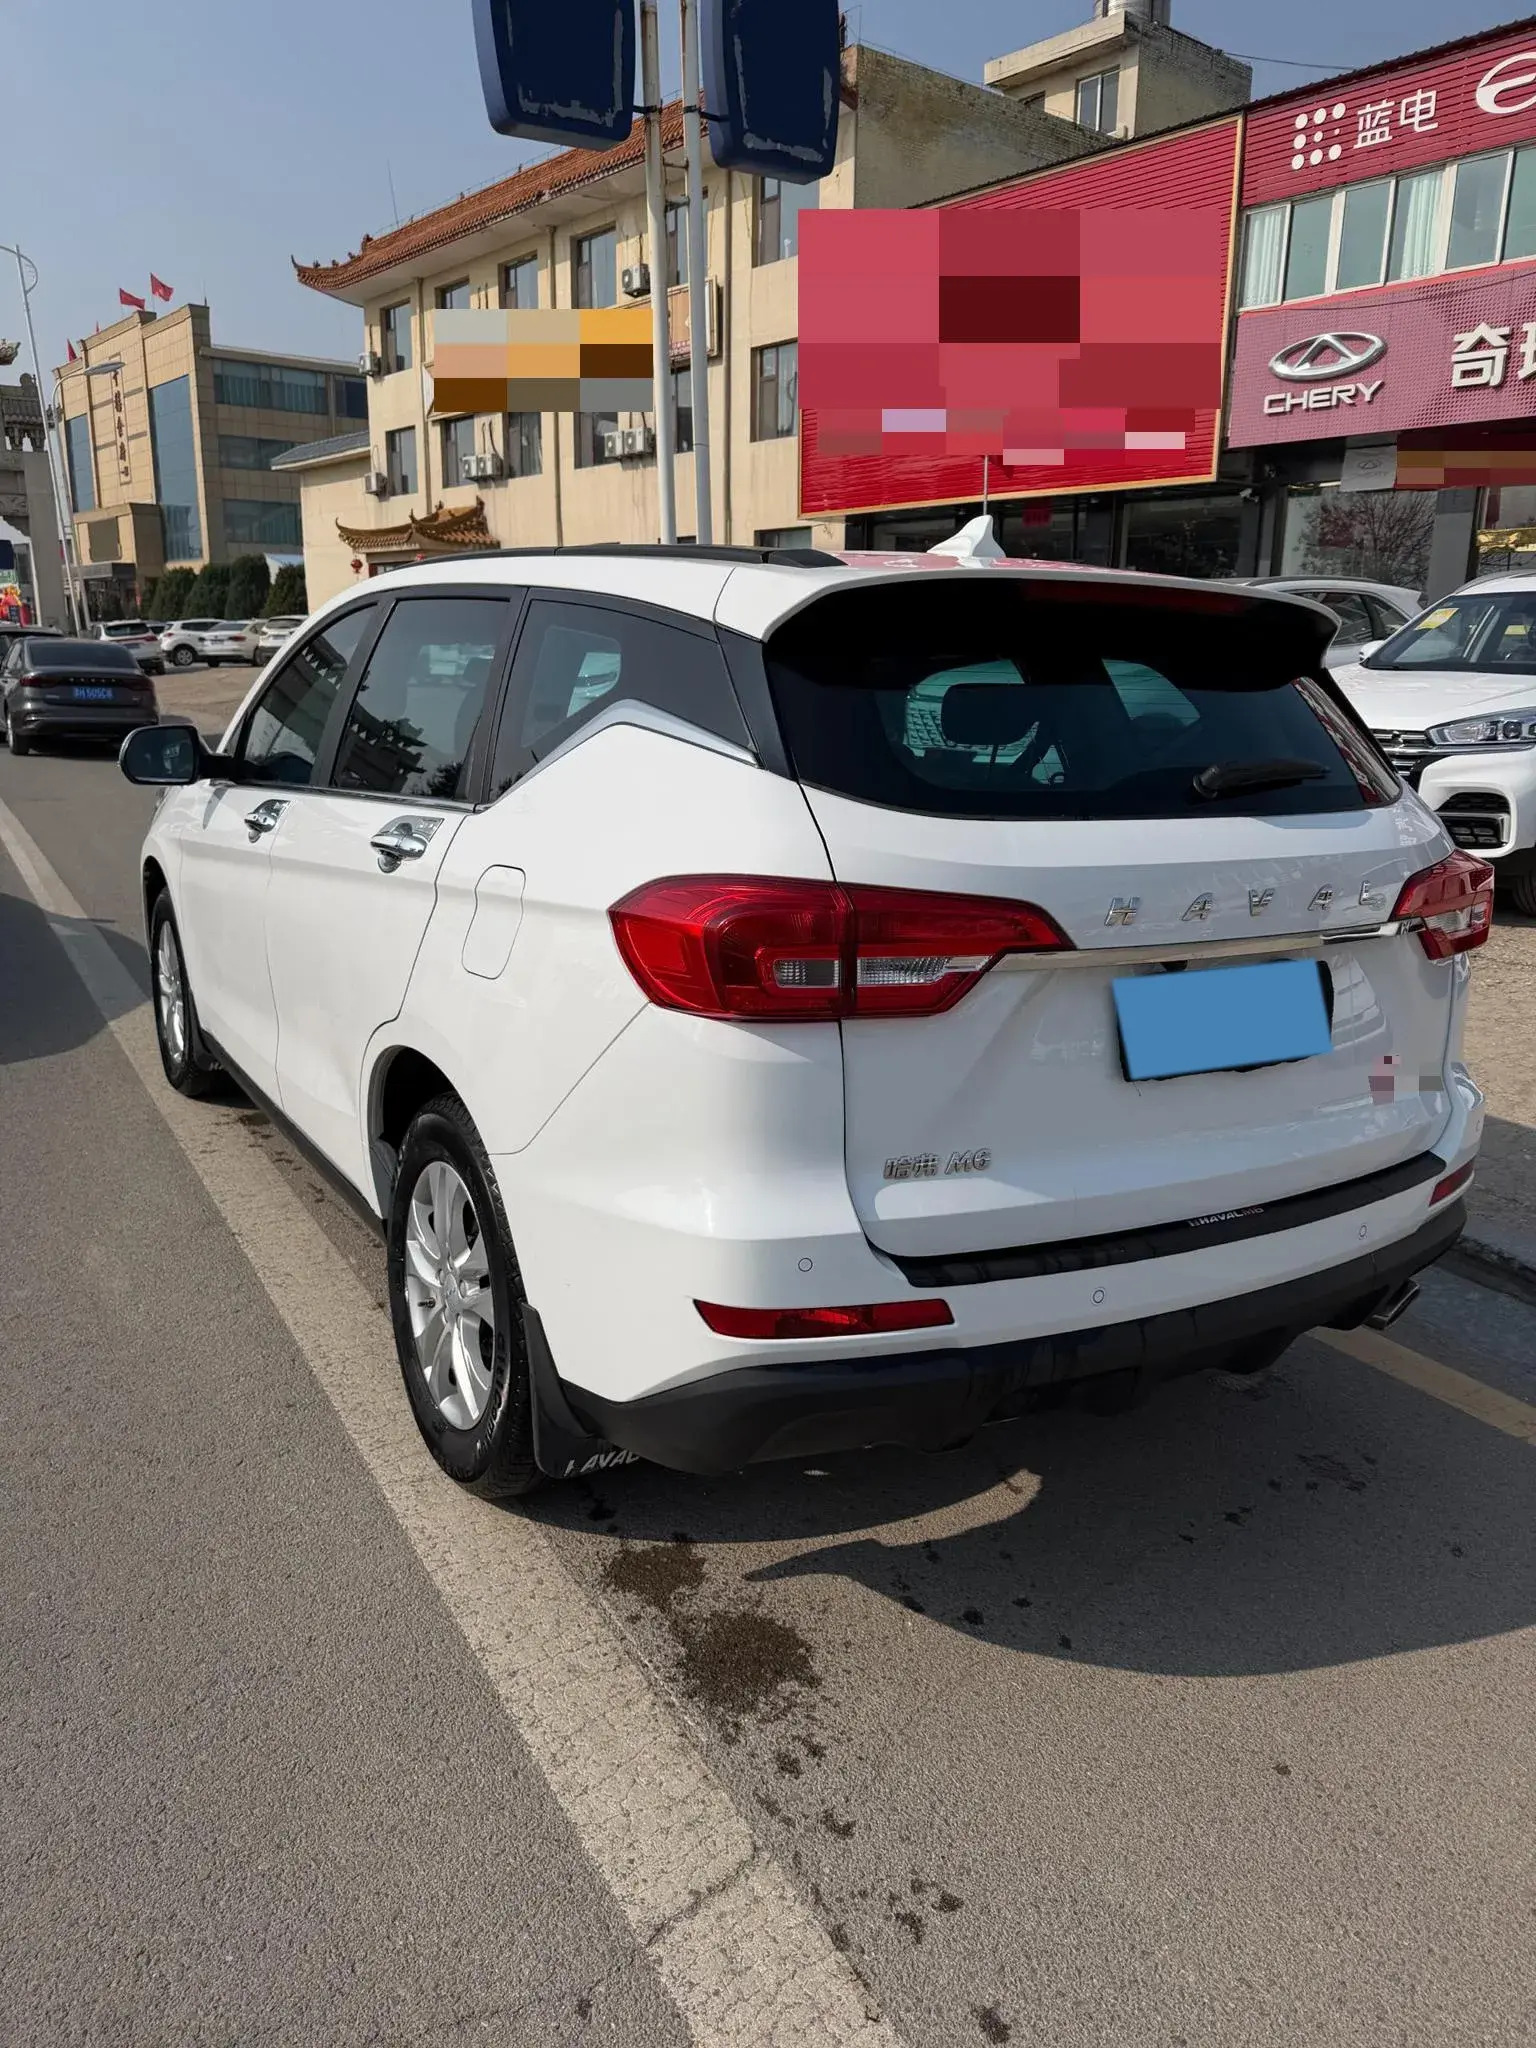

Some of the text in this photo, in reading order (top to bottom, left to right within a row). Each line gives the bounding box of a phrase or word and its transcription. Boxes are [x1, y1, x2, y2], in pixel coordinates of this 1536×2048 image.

[1353, 88, 1439, 149] 蓝电
[1263, 380, 1384, 414] CHERY
[1104, 879, 1386, 926] HAVAL
[944, 1147, 992, 1175] M6
